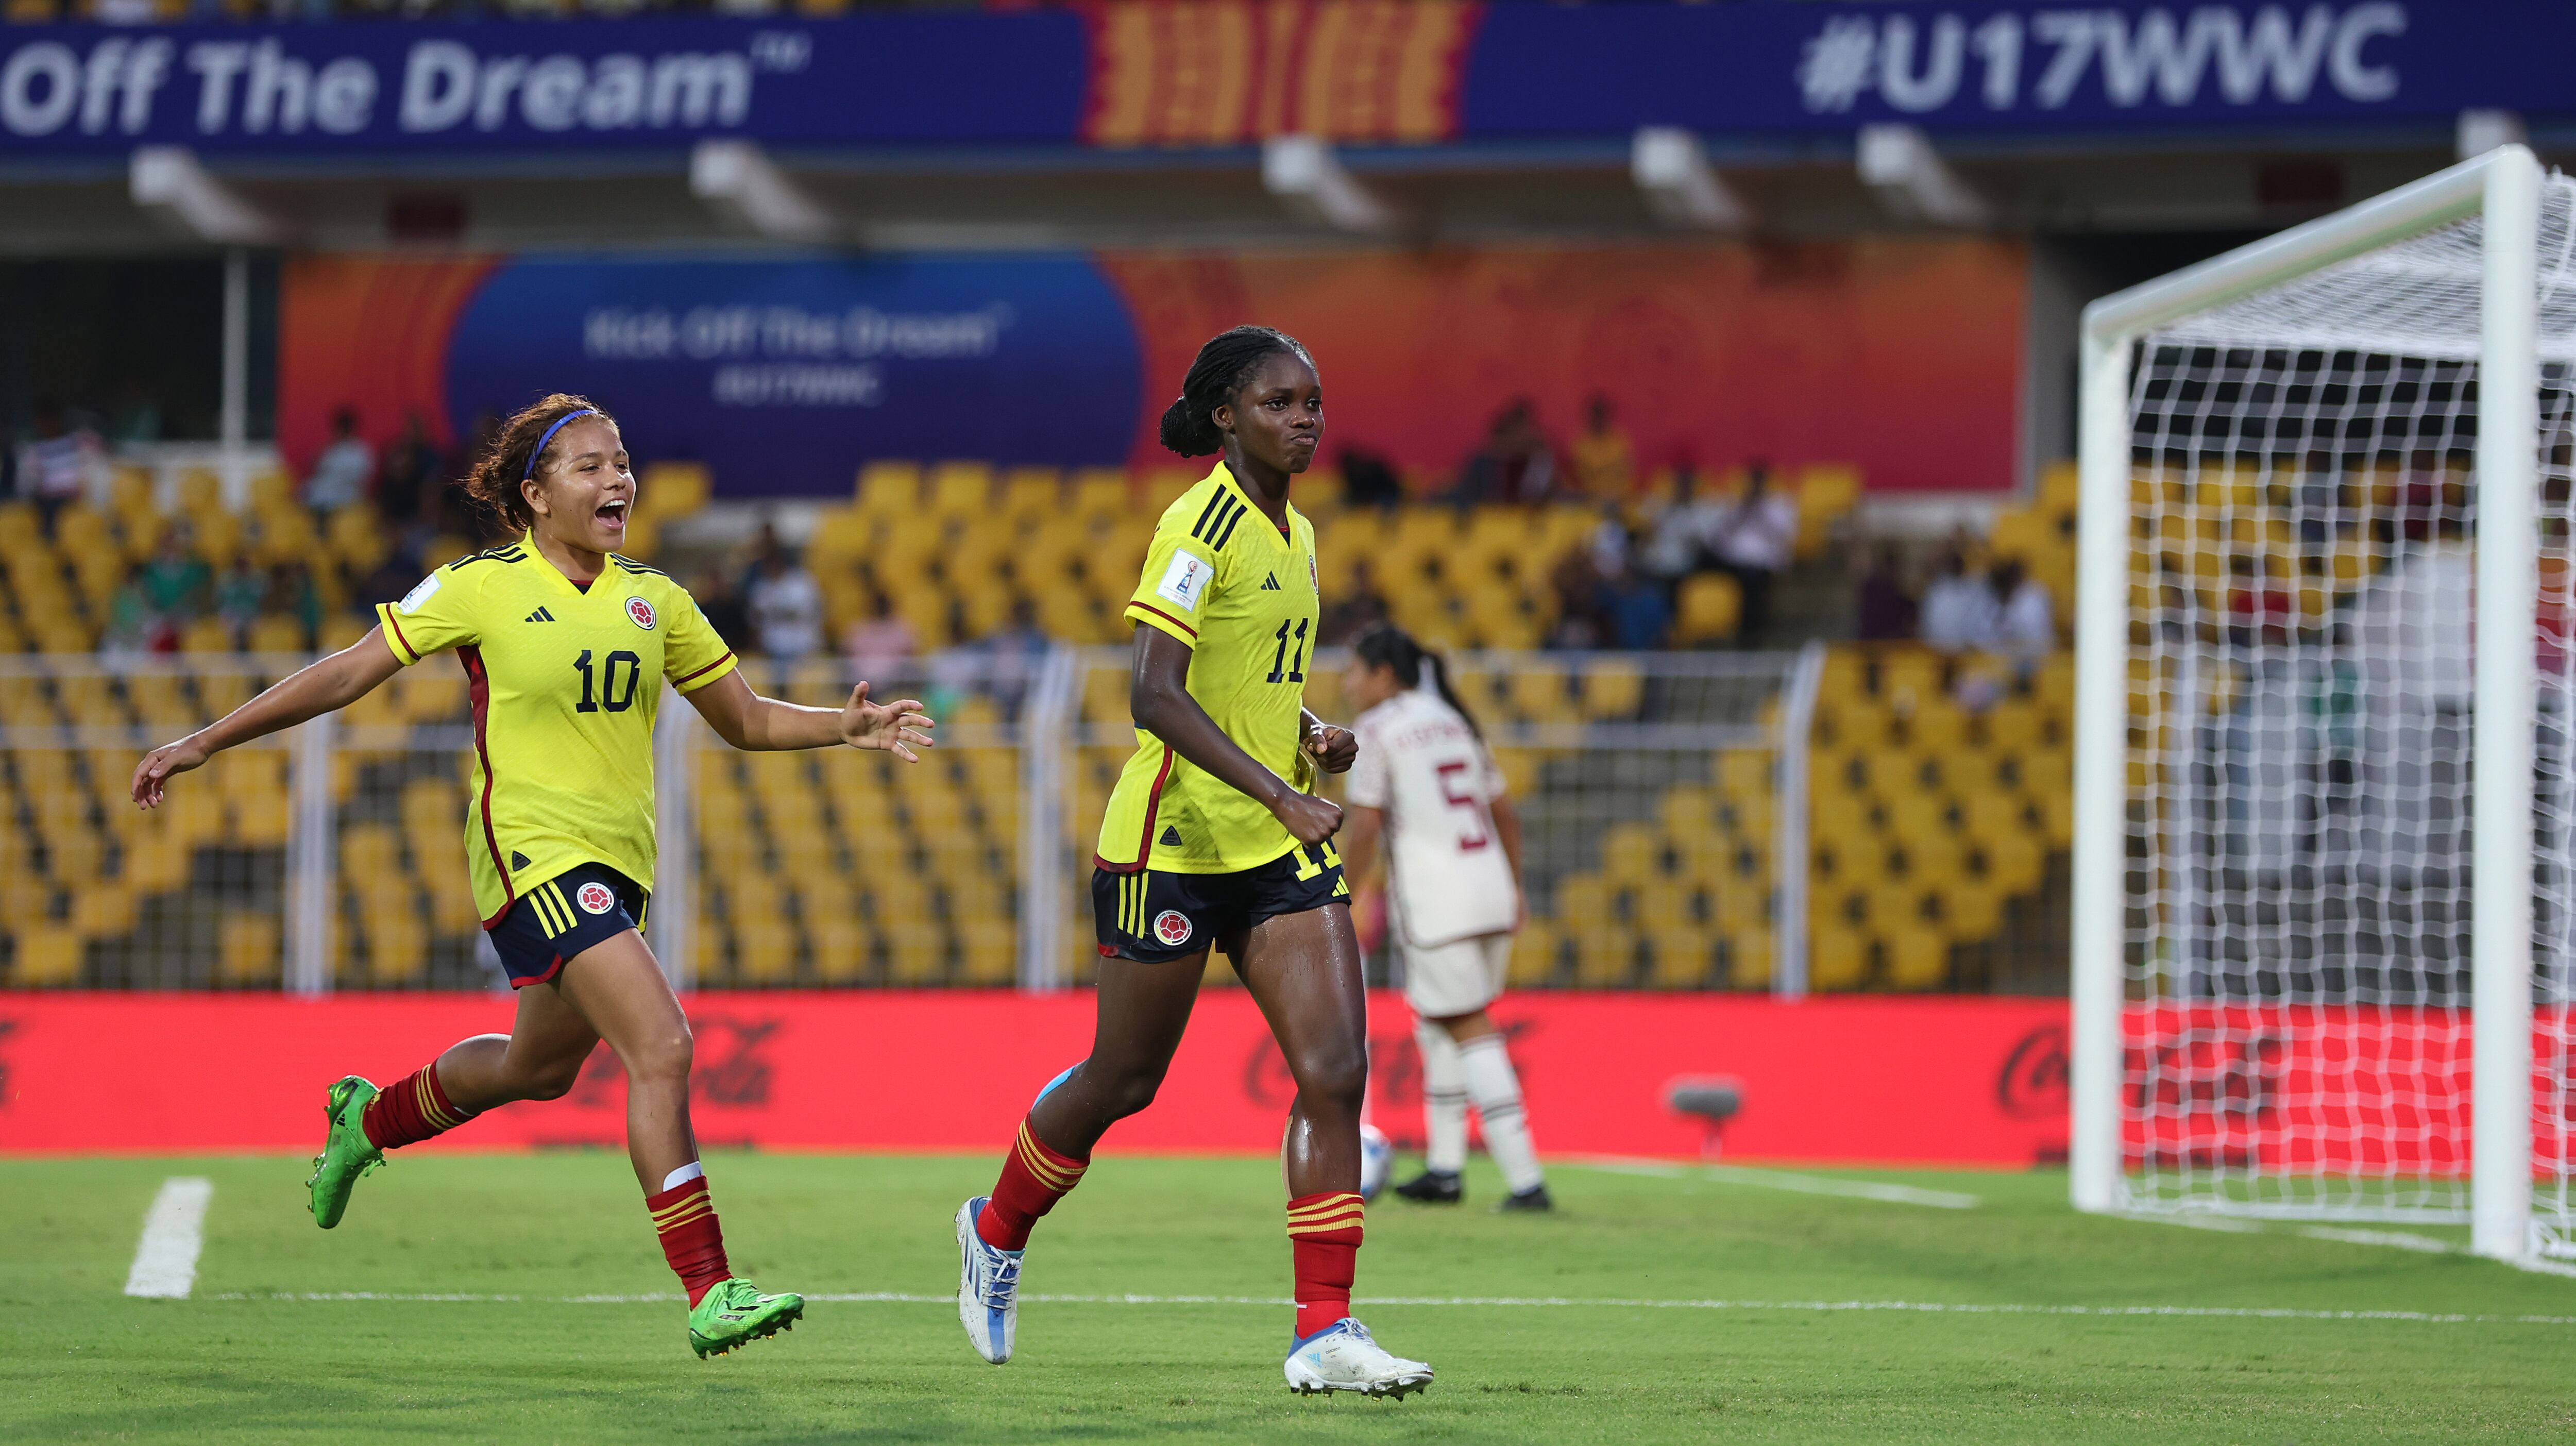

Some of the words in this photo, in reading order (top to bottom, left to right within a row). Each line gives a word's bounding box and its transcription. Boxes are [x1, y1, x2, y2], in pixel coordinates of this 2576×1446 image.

[0, 35, 174, 135] Off
[187, 37, 378, 133] The
[1799, 4, 2407, 111] #U17WWC
[573, 649, 640, 713] 10
[1266, 617, 1308, 683] 11
[1435, 760, 1490, 853] 5
